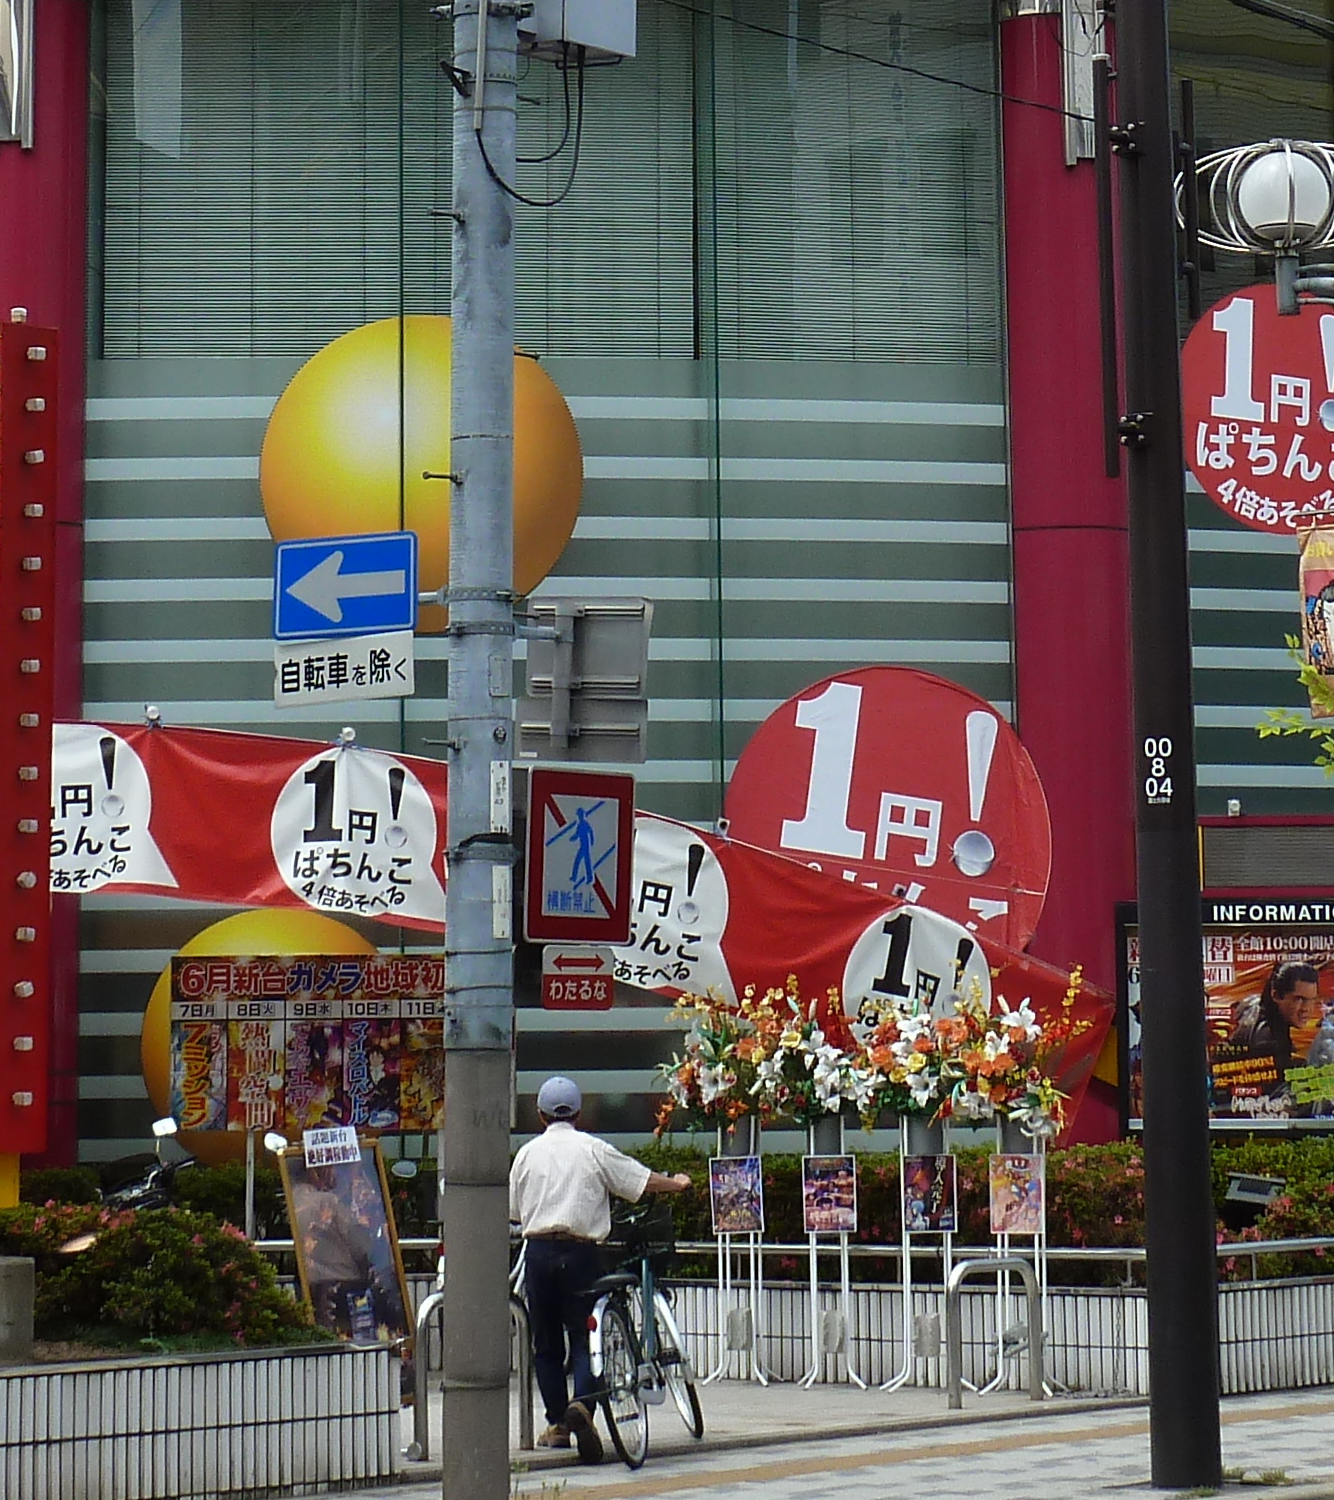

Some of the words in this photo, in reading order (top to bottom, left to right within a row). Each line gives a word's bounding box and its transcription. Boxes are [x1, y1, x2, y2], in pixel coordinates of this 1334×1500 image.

[280, 647, 408, 695] 自転車を除く
[1144, 737, 1172, 758] 00
[49, 737, 126, 818] 円!
[780, 681, 999, 878] 1円!
[1151, 757, 1166, 778] 8
[303, 759, 409, 849] 1円!
[1145, 777, 1174, 797] 04
[49, 824, 132, 857] ちんこ
[49, 855, 127, 890] あそべる
[293, 847, 413, 885] ぱちんこ
[302, 881, 407, 914] 4倍あそべる
[635, 844, 705, 925] 円!
[547, 890, 596, 914] 横断禁止
[548, 979, 608, 1001] わたるな
